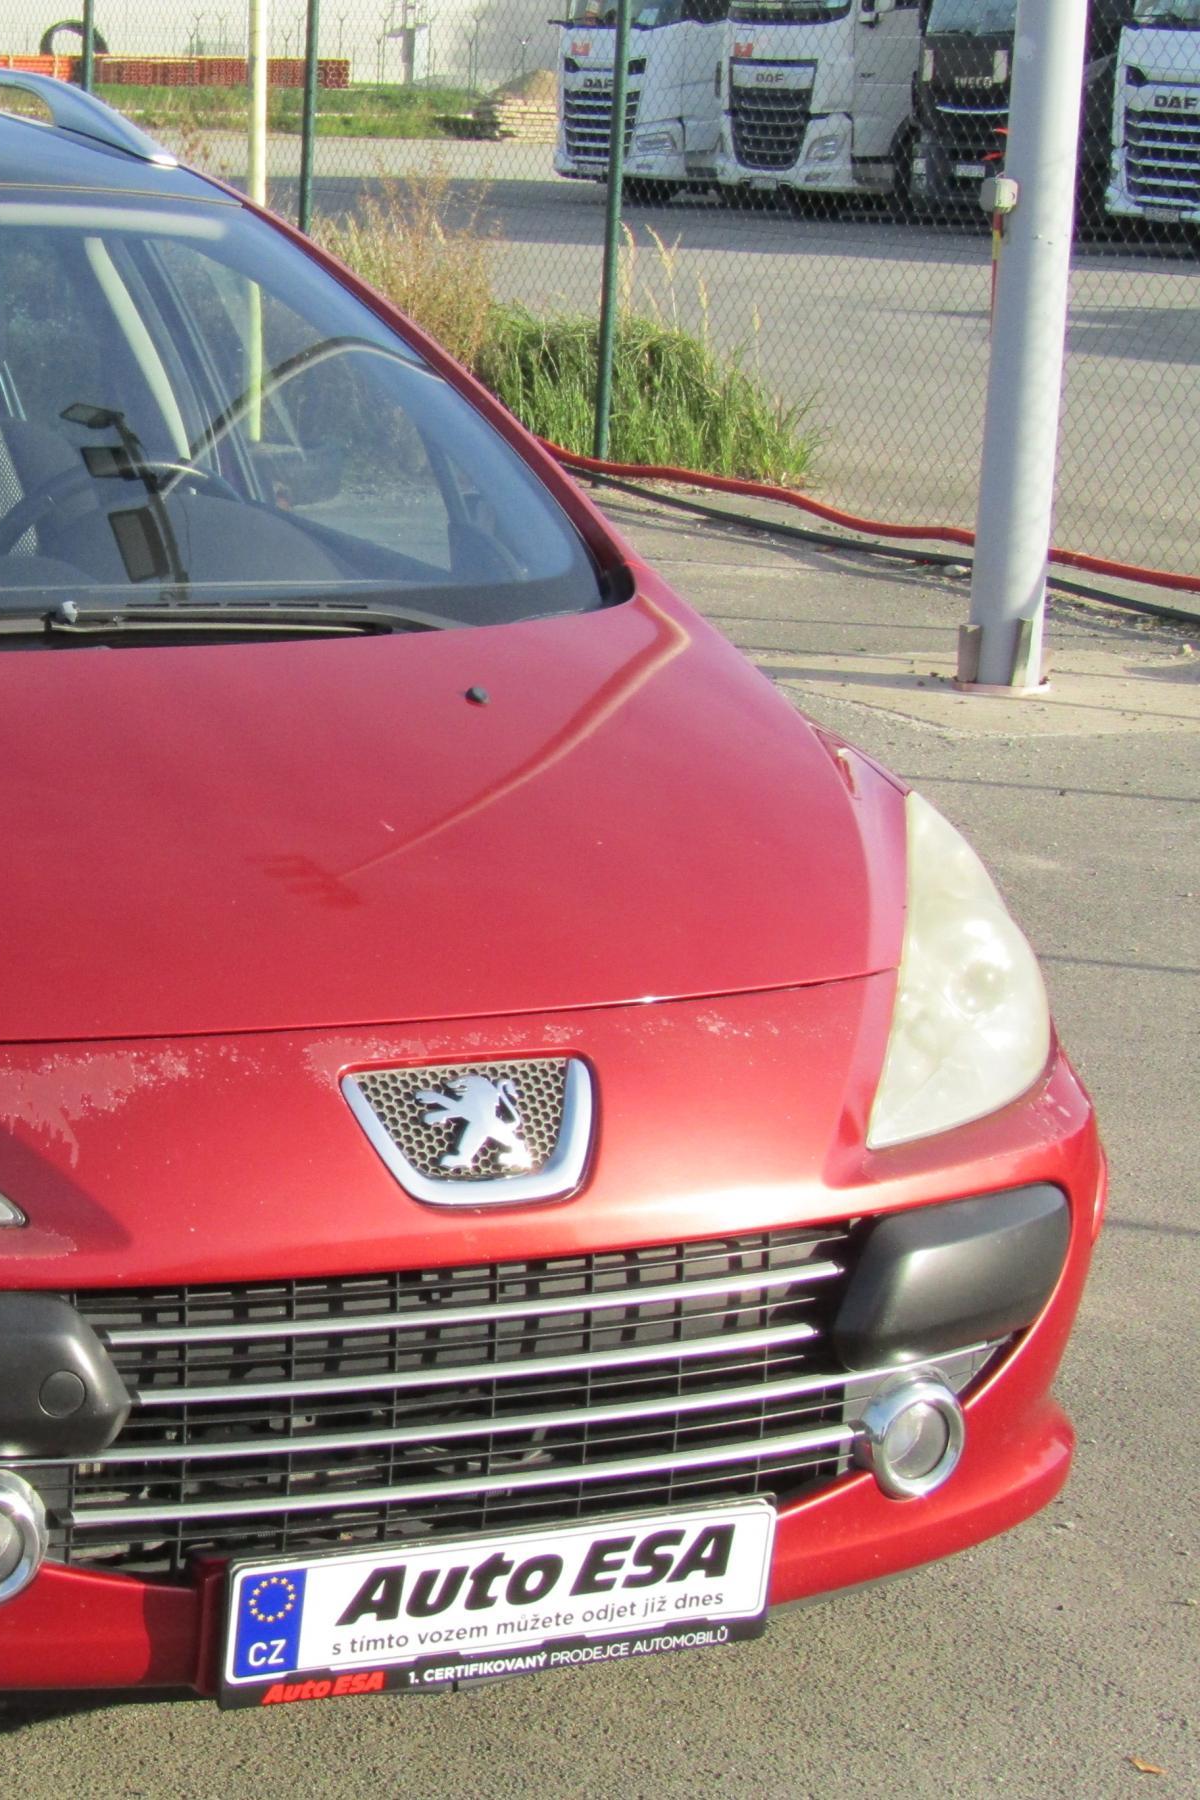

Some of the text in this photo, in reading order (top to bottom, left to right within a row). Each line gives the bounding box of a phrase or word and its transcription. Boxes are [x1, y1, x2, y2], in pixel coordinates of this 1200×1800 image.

[755, 72, 784, 83] DAF
[954, 76, 992, 90] IVECO
[1154, 94, 1198, 109] DAF
[334, 1523, 735, 1627] Auto ESA
[331, 1591, 724, 1656] s tímto vozem můžete odjet již dnes
[248, 1639, 288, 1667] CZ
[407, 1625, 729, 1685] 1. CERTIFIKOVANÝ PRODEJCE AUTOMOBILŮ
[261, 1670, 385, 1706] Auto ESA
